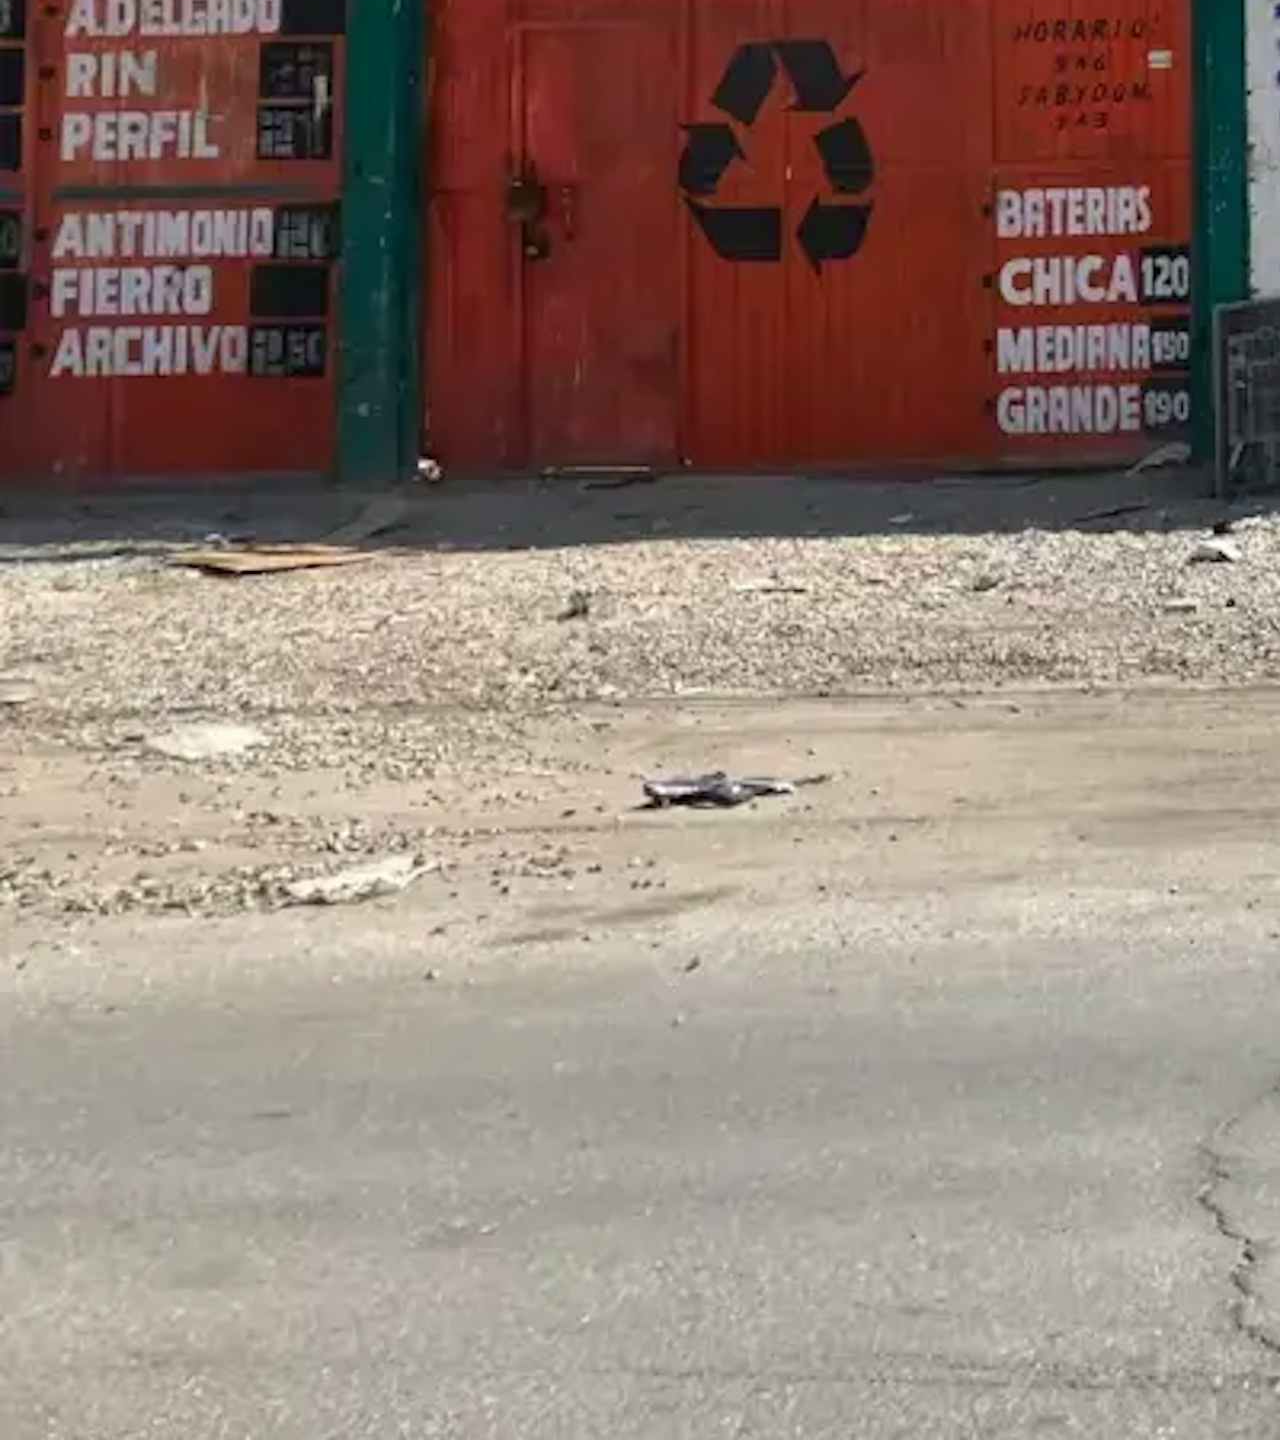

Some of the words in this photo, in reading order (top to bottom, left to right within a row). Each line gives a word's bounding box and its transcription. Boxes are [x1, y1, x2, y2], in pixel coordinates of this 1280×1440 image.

[66, 50, 158, 98] RIN
[61, 109, 220, 161] PERFIL
[51, 208, 275, 259] ANTIMONIO
[997, 185, 1152, 239] BATERIAS
[49, 265, 212, 317] FIERRO
[1000, 255, 1138, 306] CHICA
[1141, 255, 1190, 297] 120
[49, 325, 249, 377] ARCHIVO
[997, 323, 1150, 373] MEDIANA
[997, 384, 1142, 434] GRANDE
